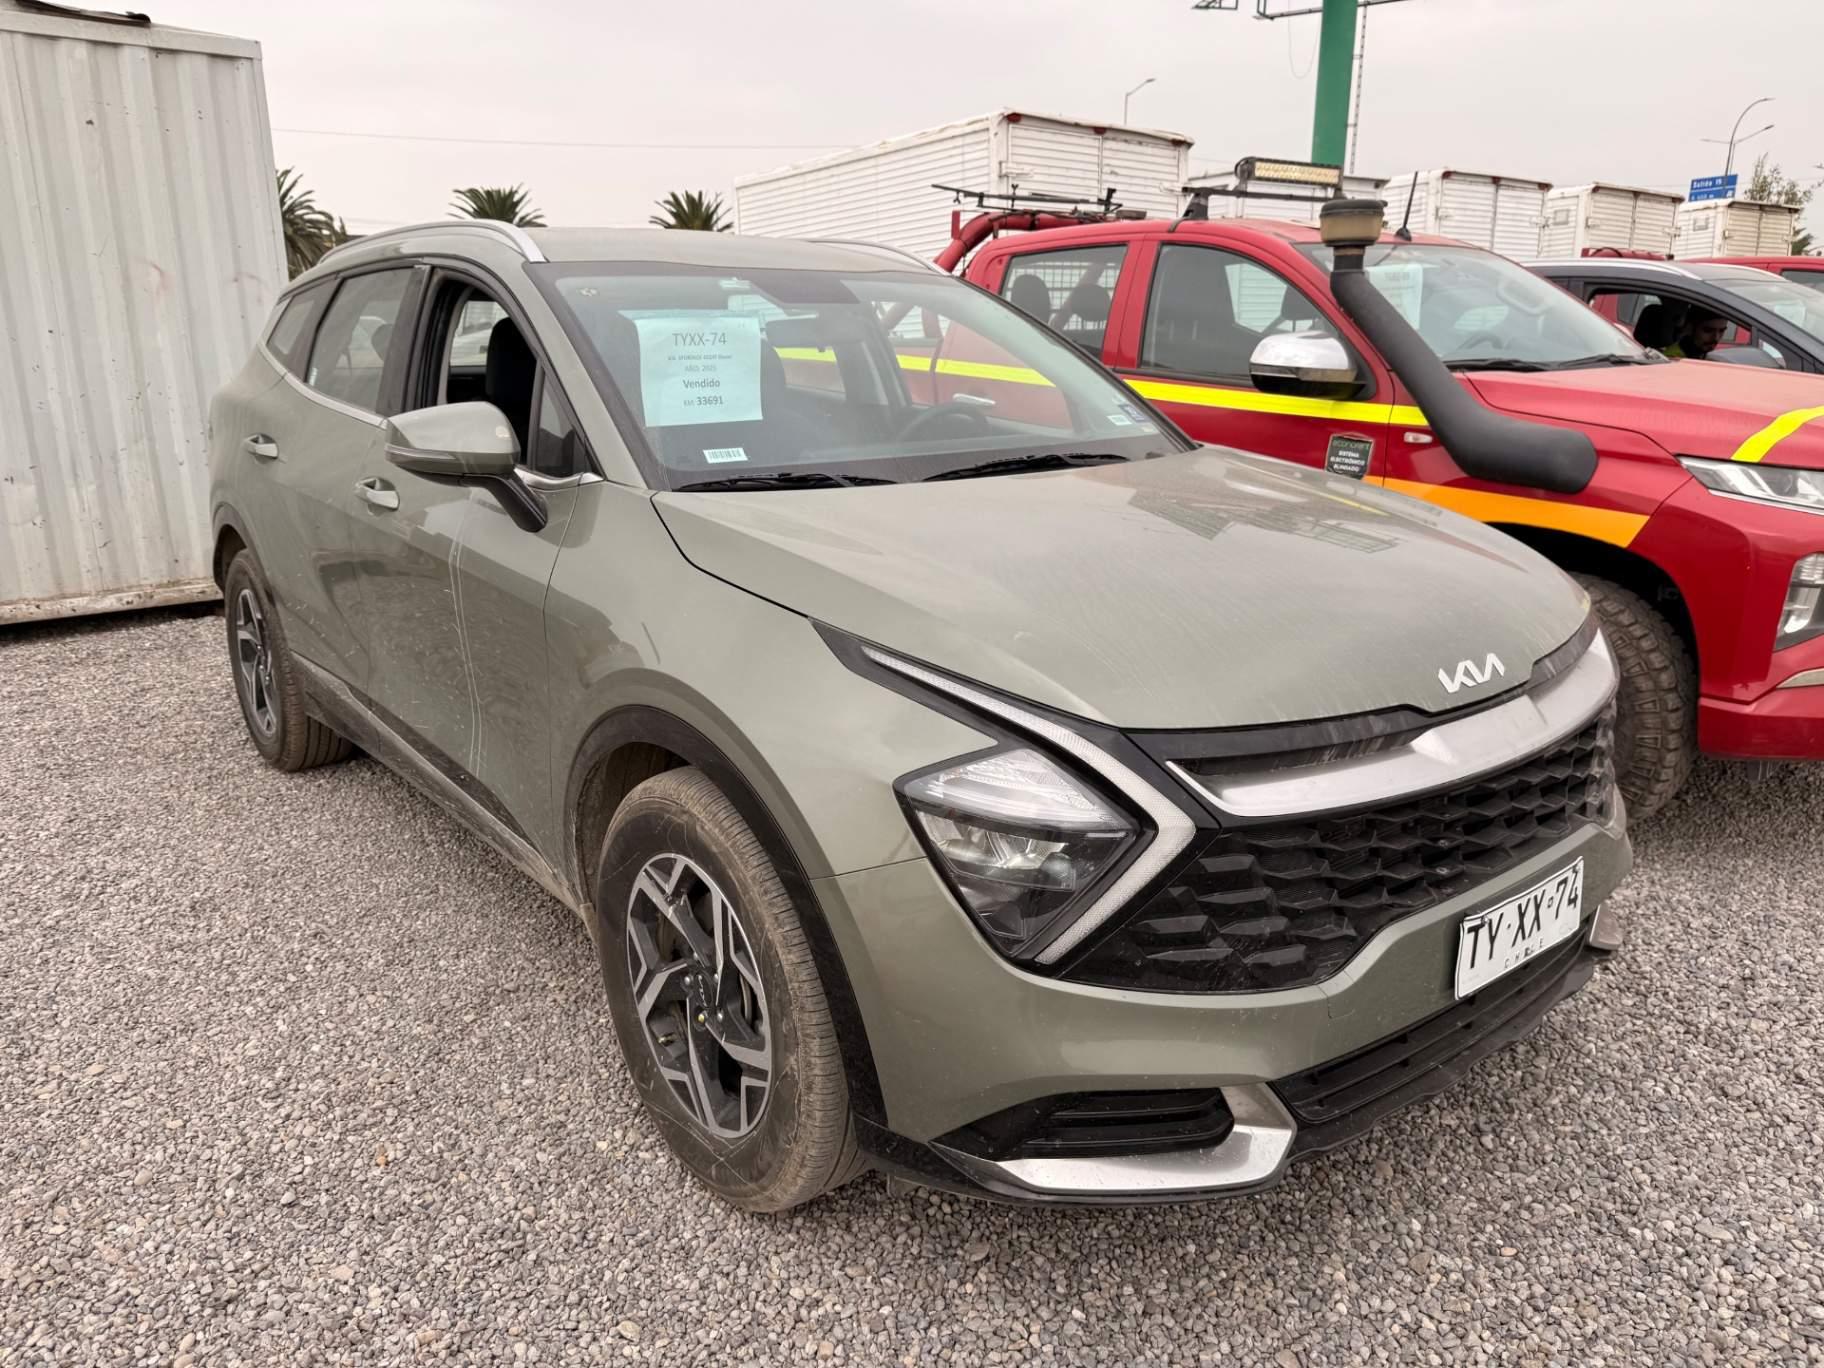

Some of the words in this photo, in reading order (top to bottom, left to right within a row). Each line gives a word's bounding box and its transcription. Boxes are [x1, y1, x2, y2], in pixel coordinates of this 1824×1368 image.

[672, 332, 727, 346] TYXX-74
[682, 378, 721, 389] Vendido
[696, 395, 724, 406] 33691
